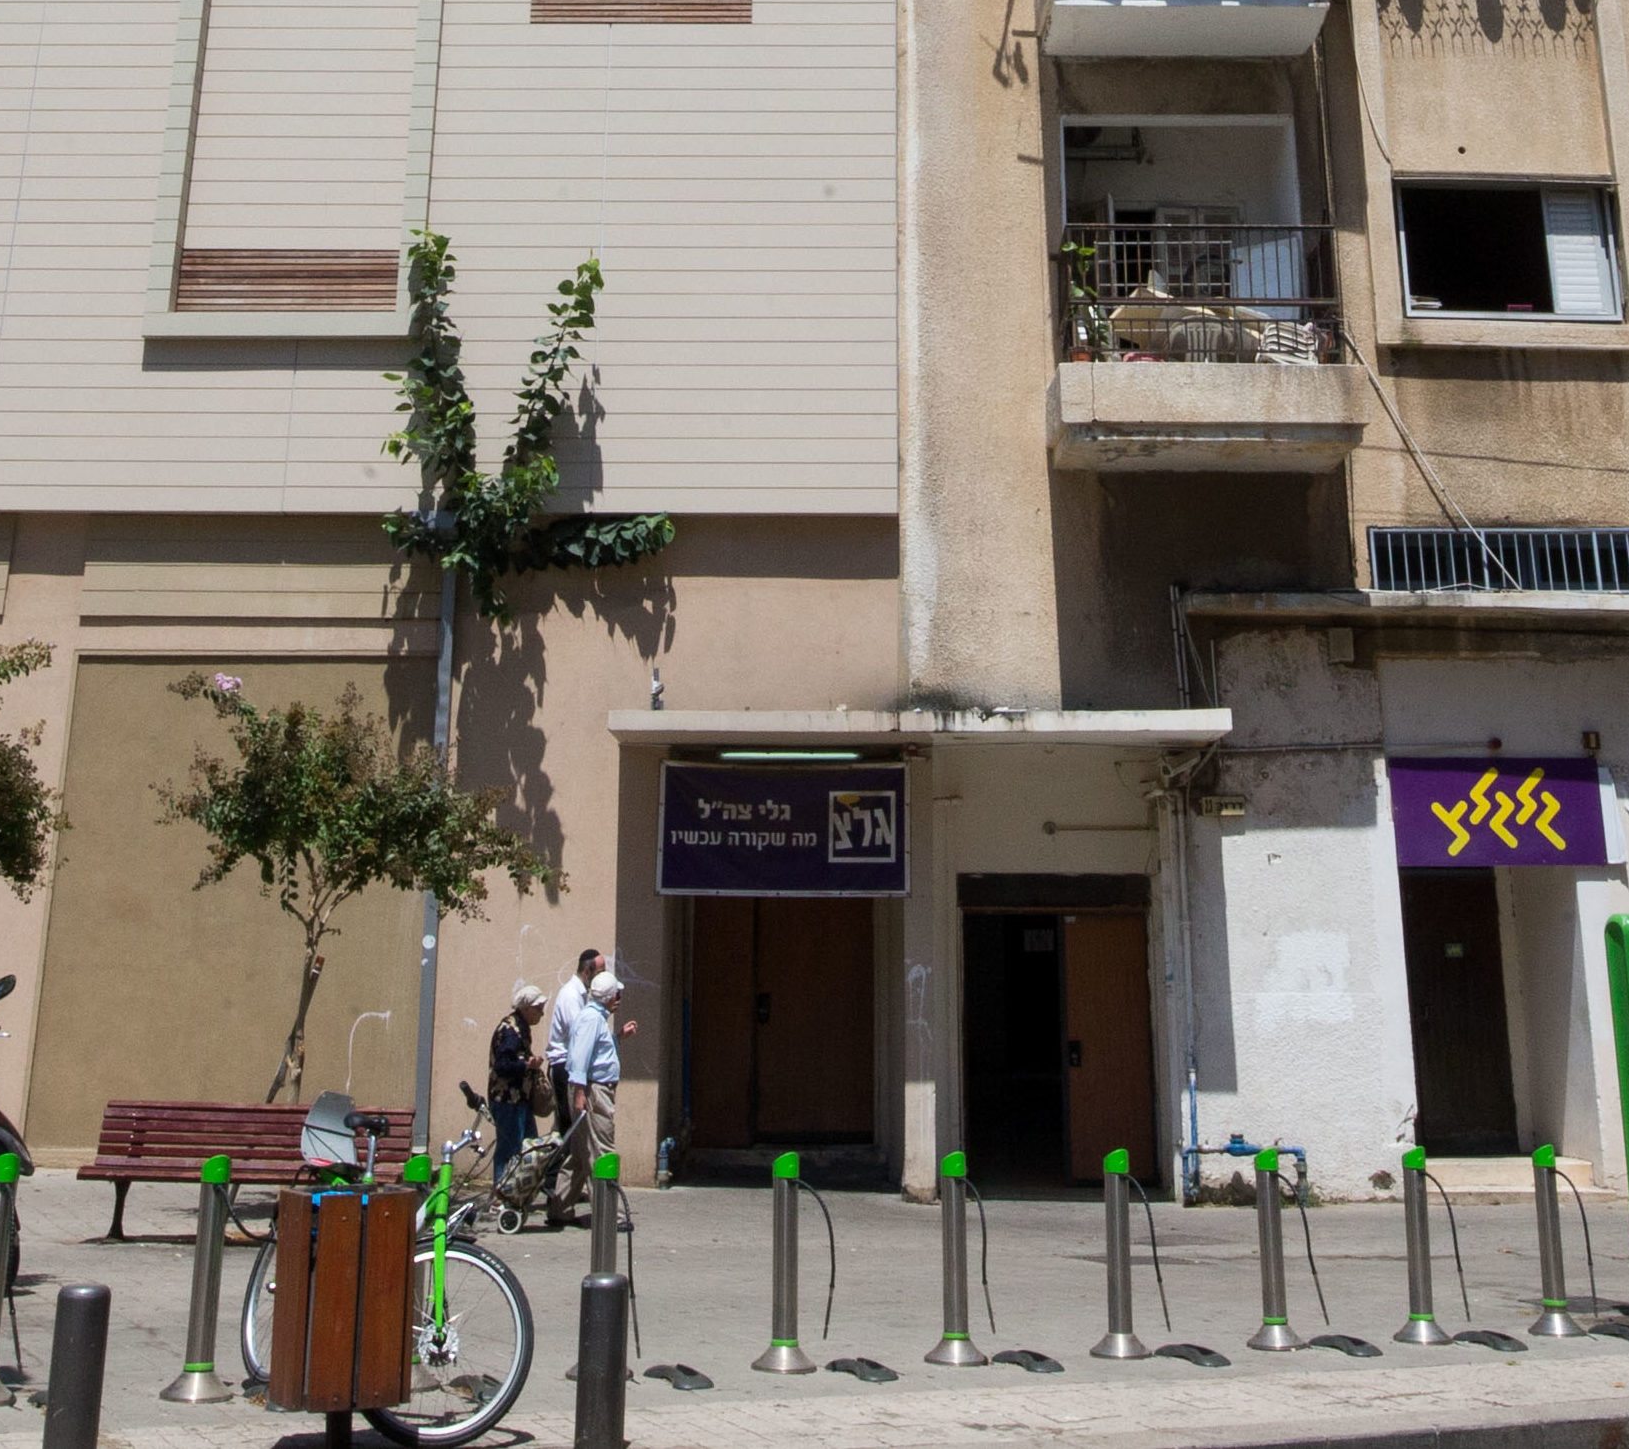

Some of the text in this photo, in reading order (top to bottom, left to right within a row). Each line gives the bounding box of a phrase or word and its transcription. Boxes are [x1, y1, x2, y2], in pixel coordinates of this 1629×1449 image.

[759, 799, 792, 821] גלי
[670, 830, 818, 851] מה שקורה עכשיו
